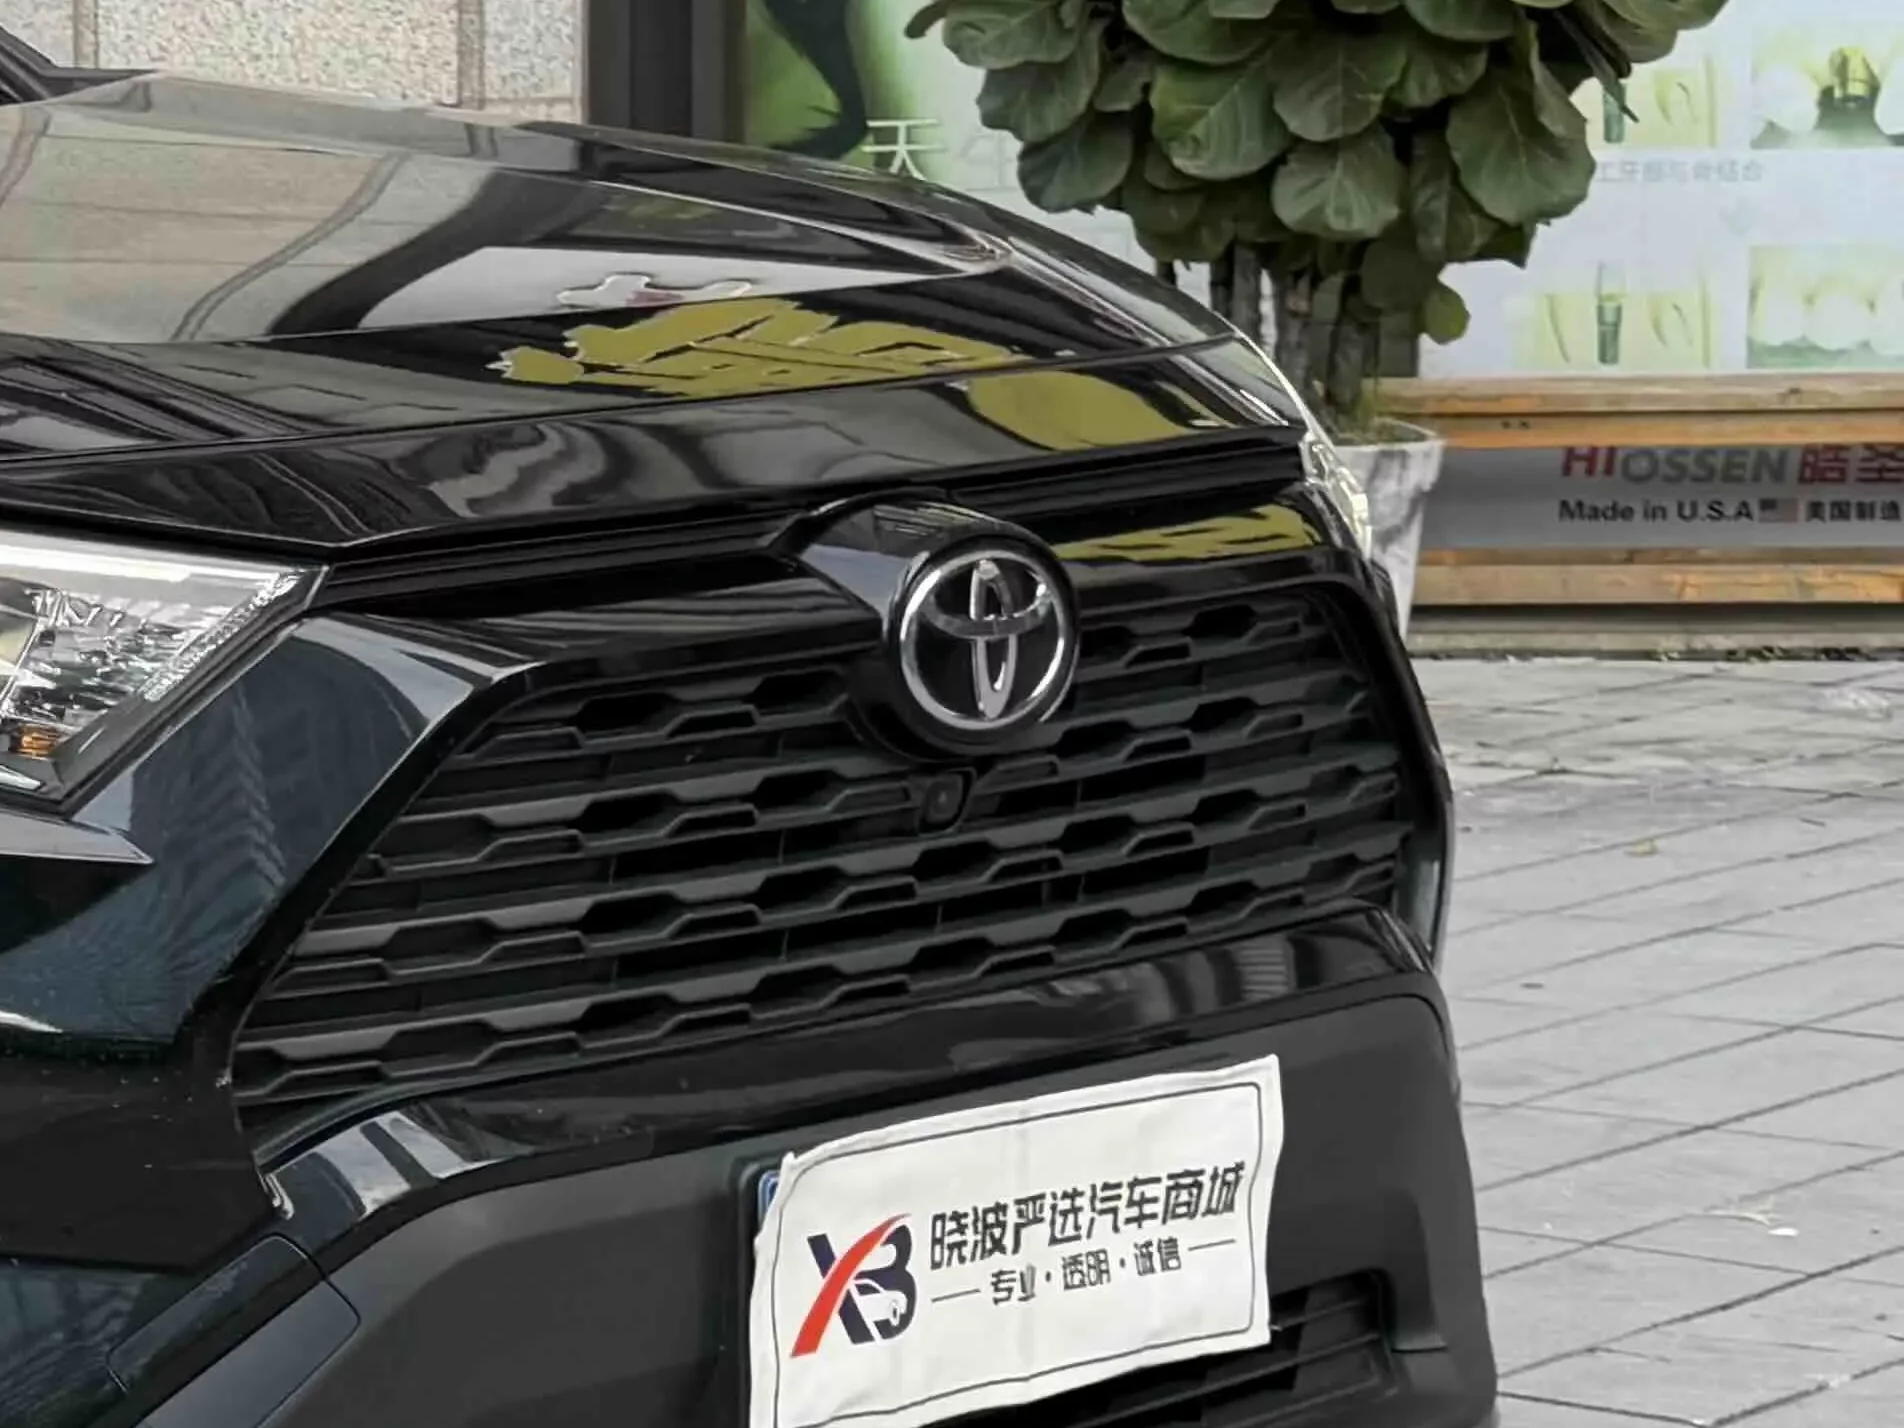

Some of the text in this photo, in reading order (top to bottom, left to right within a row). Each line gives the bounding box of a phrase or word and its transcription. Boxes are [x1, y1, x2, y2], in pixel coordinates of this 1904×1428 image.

[1562, 444, 1791, 486] HIOSSEN
[1559, 498, 1903, 525] Made in U.S.A 美国制造
[929, 1159, 1247, 1271] 晓波严选汽车商城
